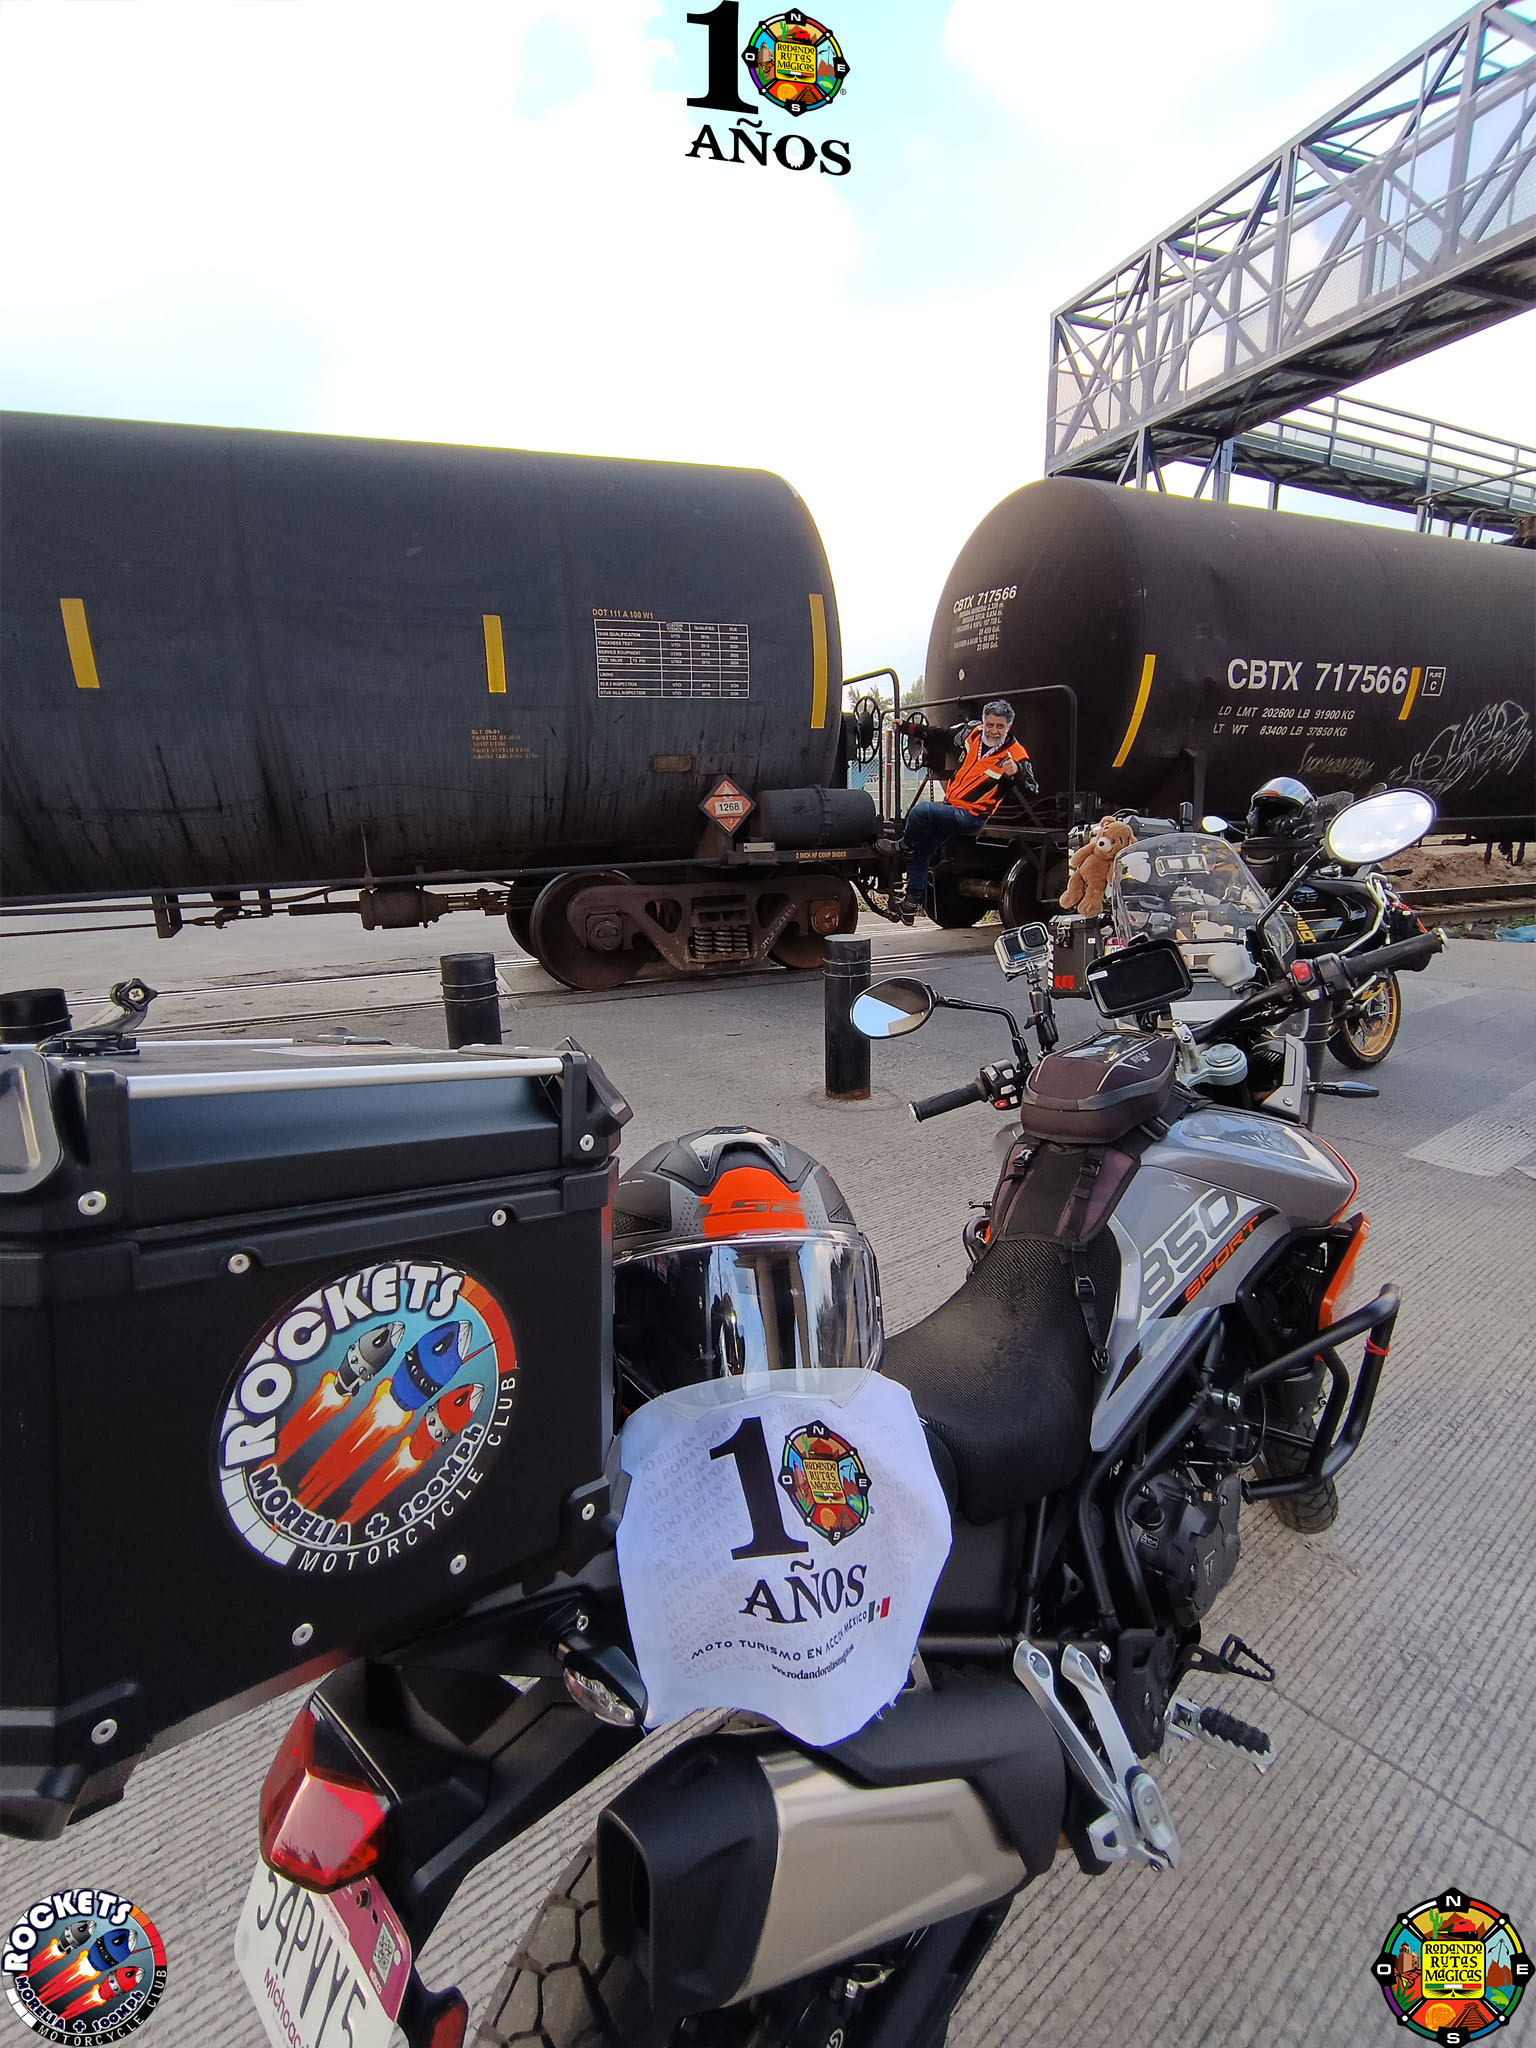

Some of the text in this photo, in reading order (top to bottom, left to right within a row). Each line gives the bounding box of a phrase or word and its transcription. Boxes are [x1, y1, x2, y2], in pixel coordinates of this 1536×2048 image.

[592, 608, 608, 616] DOT
[610, 609, 621, 617] 111
[622, 610, 629, 618] A
[630, 611, 642, 619] 100
[953, 595, 974, 614] CBTX
[977, 585, 1017, 606] 717566
[1227, 658, 1409, 695] CBTX 717566
[1430, 680, 1437, 691] C
[1218, 705, 1232, 716] LD
[1236, 706, 1258, 718] LMT
[1261, 707, 1295, 719] 202600
[1297, 708, 1311, 719] LB
[1213, 723, 1225, 734] LT
[1232, 724, 1249, 735] WT
[1289, 726, 1303, 736] LB
[718, 802, 740, 812] 1268
[1141, 1188, 1239, 1308] 850
[1184, 1215, 1259, 1302] SPORT
[223, 1263, 464, 1468] ROCKETS
[297, 1376, 517, 1573] MOTORCYCLE CLUB
[250, 1465, 352, 1546] MORELIA
[739, 1558, 867, 1624] AÑOS
[691, 1640, 733, 1660] MOTO
[738, 1638, 802, 1661] TURISMO
[807, 1646, 823, 1659] EN
[825, 1631, 844, 1653] ACCN
